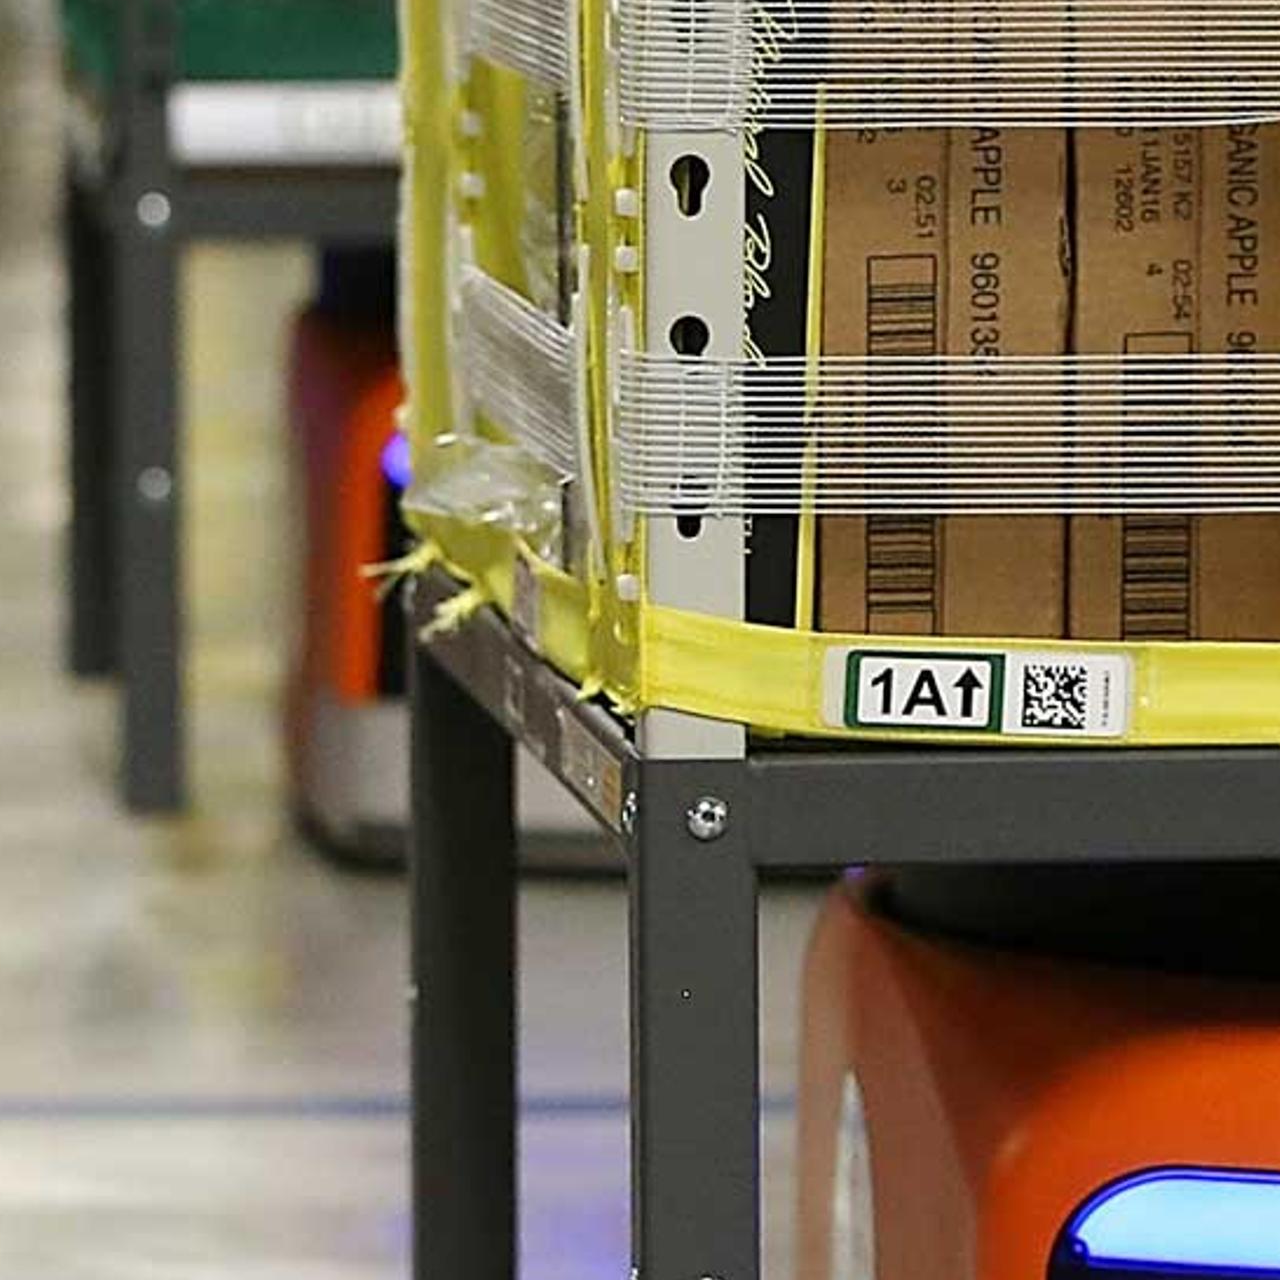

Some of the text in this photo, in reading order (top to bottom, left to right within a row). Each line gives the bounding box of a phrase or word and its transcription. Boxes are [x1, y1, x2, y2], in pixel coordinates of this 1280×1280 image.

[887, 178, 906, 195] 3
[971, 127, 1000, 225] APPLE
[1114, 165, 1134, 234] 12602
[1226, 215, 1258, 306] APPLE
[870, 667, 948, 718] 1A
